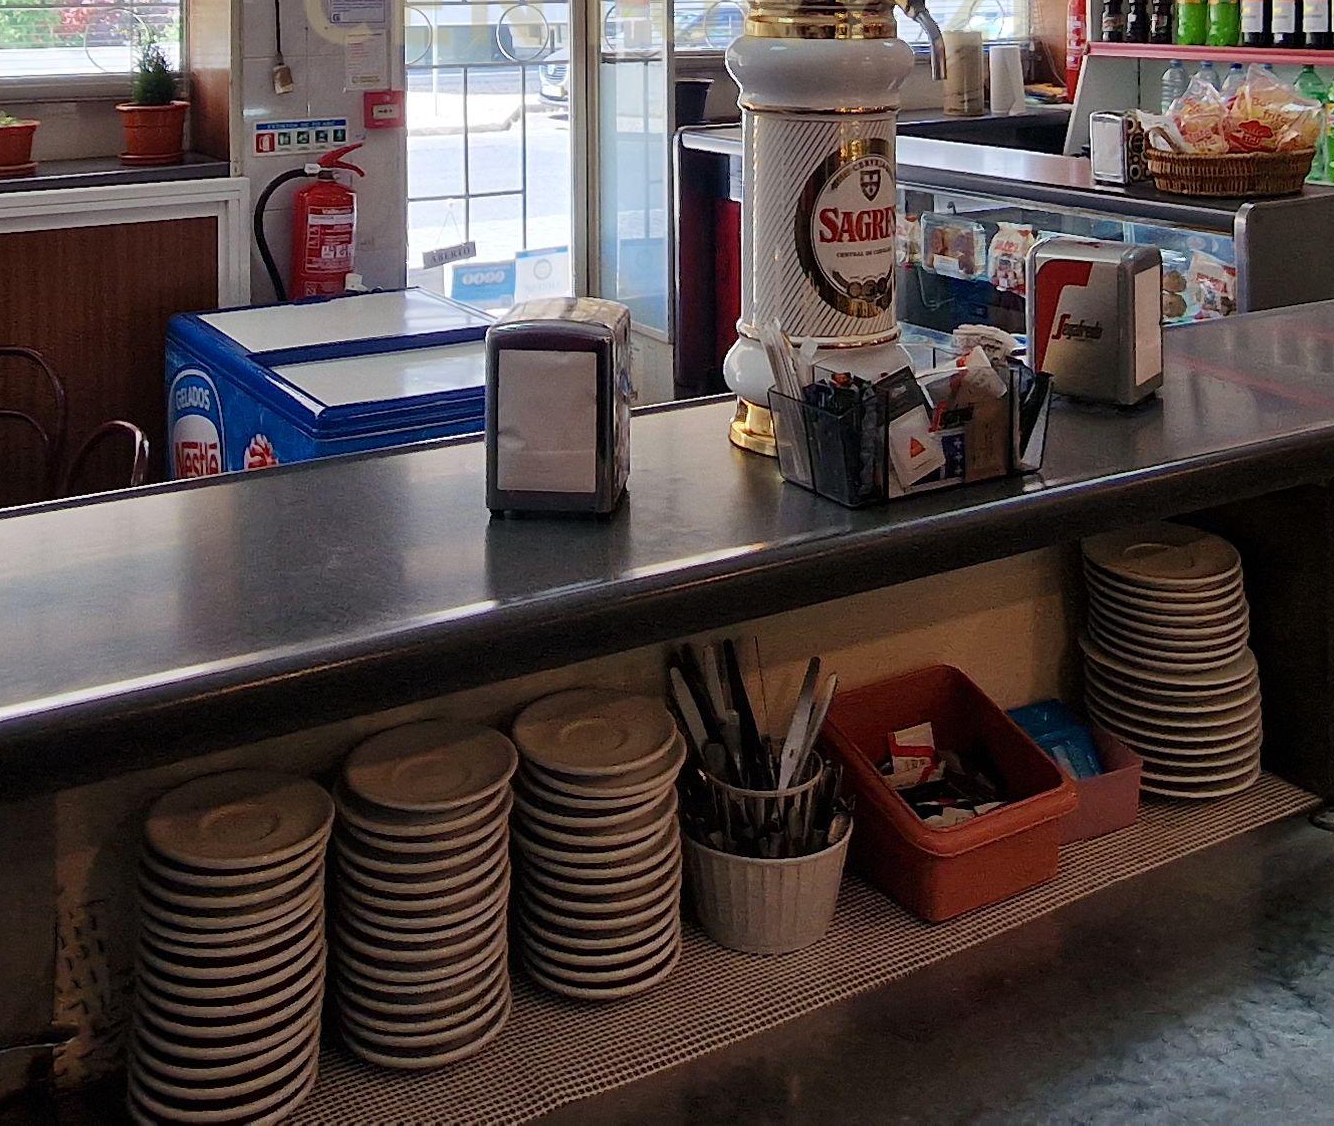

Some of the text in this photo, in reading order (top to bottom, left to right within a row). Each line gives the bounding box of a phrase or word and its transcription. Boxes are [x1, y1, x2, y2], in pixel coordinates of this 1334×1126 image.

[819, 205, 896, 243] SAGRE
[175, 385, 212, 412] GELADOS
[174, 440, 220, 480] Nestlé
